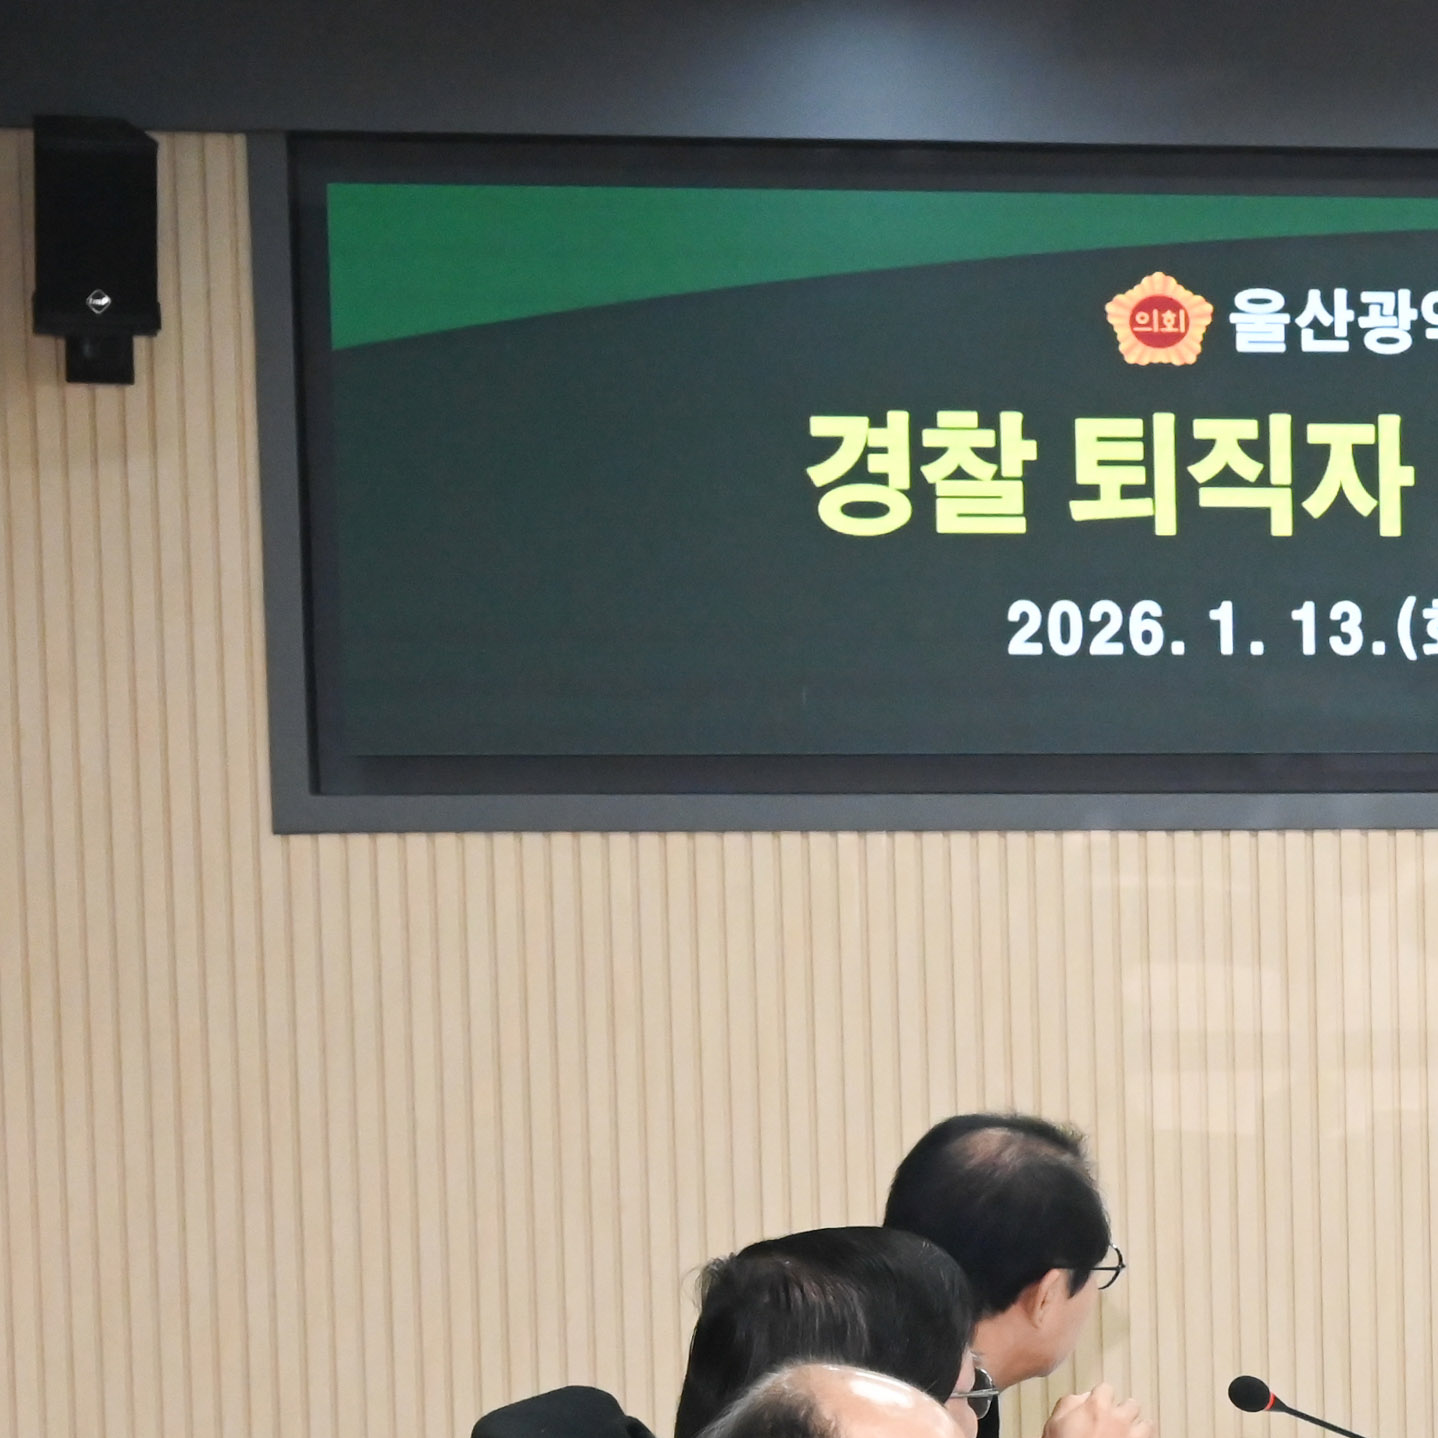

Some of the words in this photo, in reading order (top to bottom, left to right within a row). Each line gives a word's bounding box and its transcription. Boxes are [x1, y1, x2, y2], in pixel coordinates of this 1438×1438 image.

[1132, 308, 1186, 333] 의회
[805, 410, 1038, 538] 경찰
[1067, 411, 1415, 539] 퇴직자
[1007, 599, 1186, 658] 2026.
[1208, 600, 1265, 657] 1.
